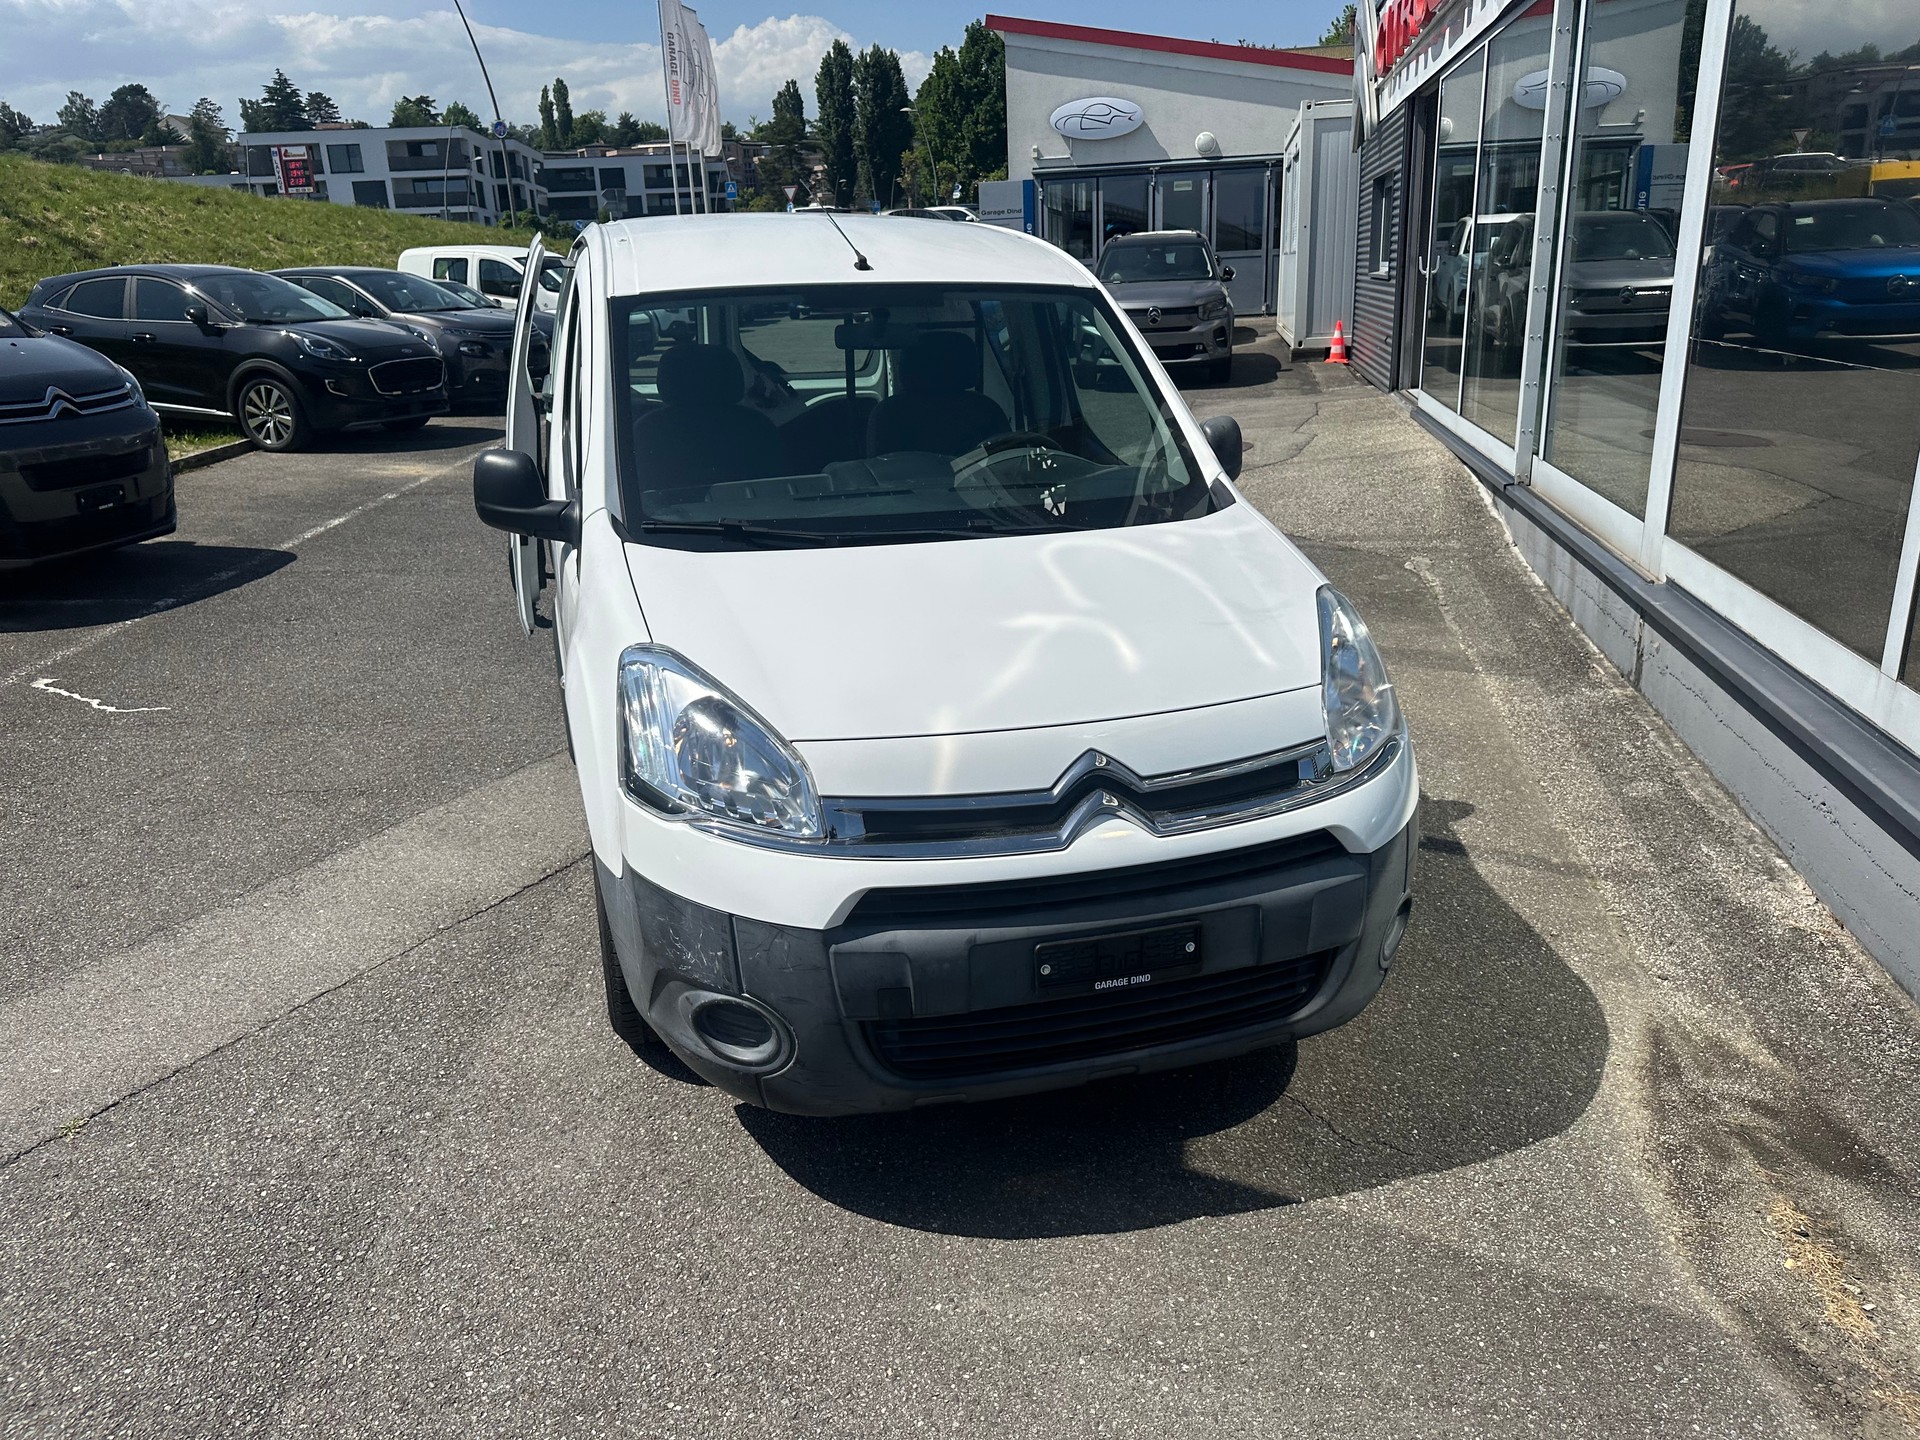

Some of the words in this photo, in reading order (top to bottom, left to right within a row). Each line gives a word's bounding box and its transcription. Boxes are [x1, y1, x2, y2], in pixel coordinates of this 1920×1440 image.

[667, 32, 679, 76] GARAGE
[671, 79, 682, 105] DIND
[274, 160, 284, 191] LAVAGE
[1094, 977, 1129, 990] GARAGE
[1130, 973, 1151, 984] DIND
